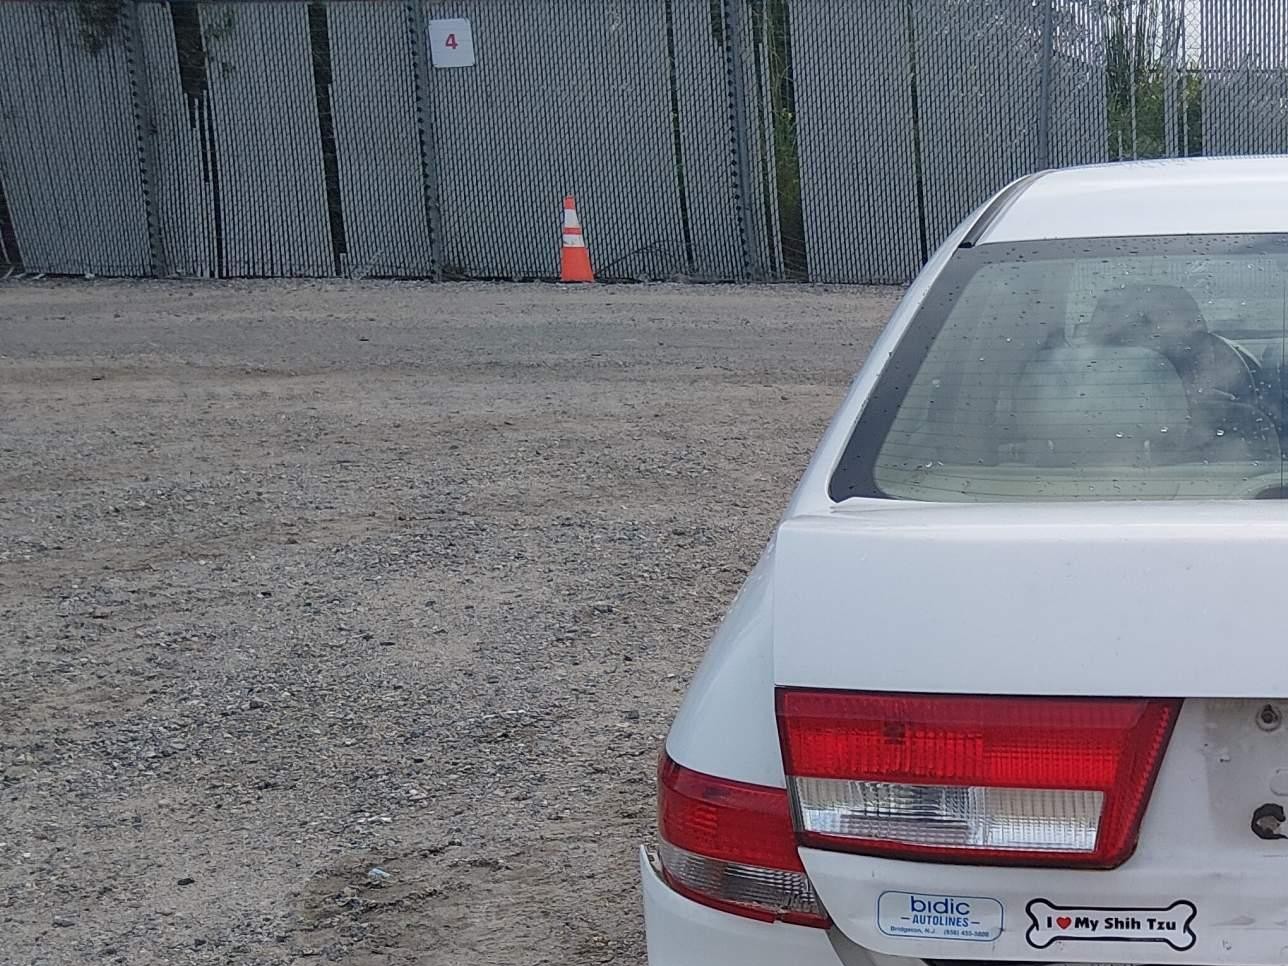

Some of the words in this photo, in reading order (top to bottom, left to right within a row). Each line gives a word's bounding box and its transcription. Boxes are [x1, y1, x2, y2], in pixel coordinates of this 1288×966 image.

[445, 33, 459, 50] 4
[910, 895, 971, 915] bidic
[912, 914, 969, 928] AUTOLINES
[1046, 916, 1053, 929] I
[1074, 916, 1099, 931] My
[1104, 917, 1141, 930] Shih
[1147, 918, 1177, 931] Tzu
